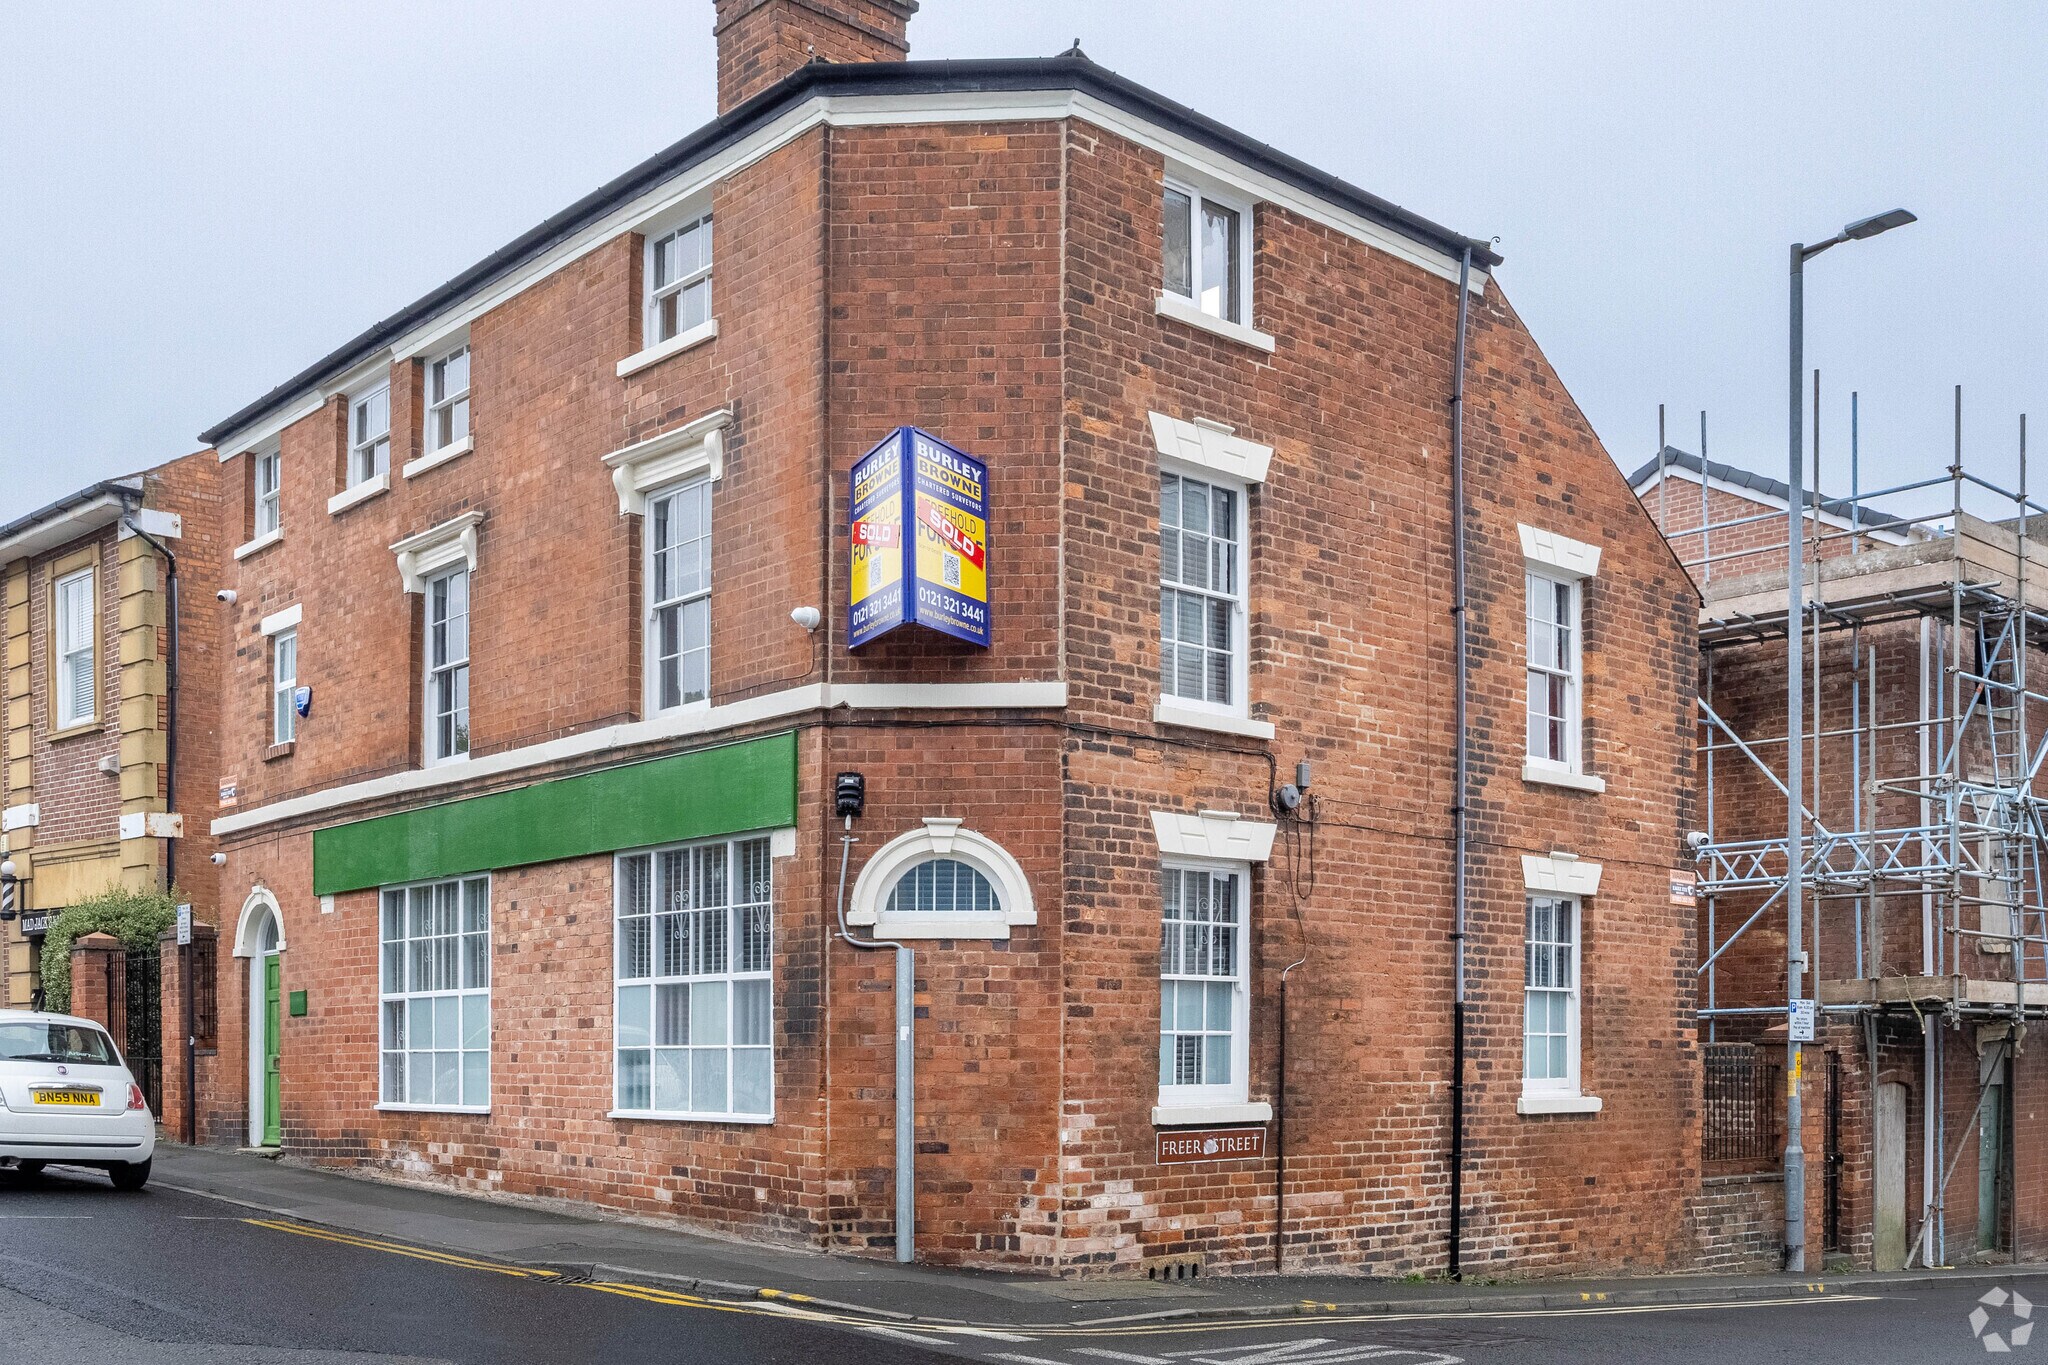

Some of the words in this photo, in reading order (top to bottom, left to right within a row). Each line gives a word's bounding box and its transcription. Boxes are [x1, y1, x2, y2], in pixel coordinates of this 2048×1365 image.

[855, 441, 900, 487] BURLEY
[917, 440, 982, 483] BURLEY
[919, 459, 981, 498] BROWNE
[856, 460, 899, 500] BROWNE
[917, 477, 950, 497] CHARTERED
[951, 492, 982, 512] SURVEYORS
[855, 495, 876, 515] CHARTERED
[859, 523, 891, 542] SOLD
[930, 508, 975, 557] SOLD
[853, 605, 868, 626] 0121
[869, 598, 882, 617] 321
[883, 587, 901, 610] 3441
[919, 586, 941, 608] 0121
[943, 595, 960, 615] 321
[961, 602, 984, 624] 3441
[919, 607, 984, 636] www.burleybrowne.co.uk
[22, 918, 34, 931] MAD
[39, 1092, 69, 1102] BN59
[72, 1093, 95, 1103] NNA
[1162, 1140, 1202, 1155] FREER
